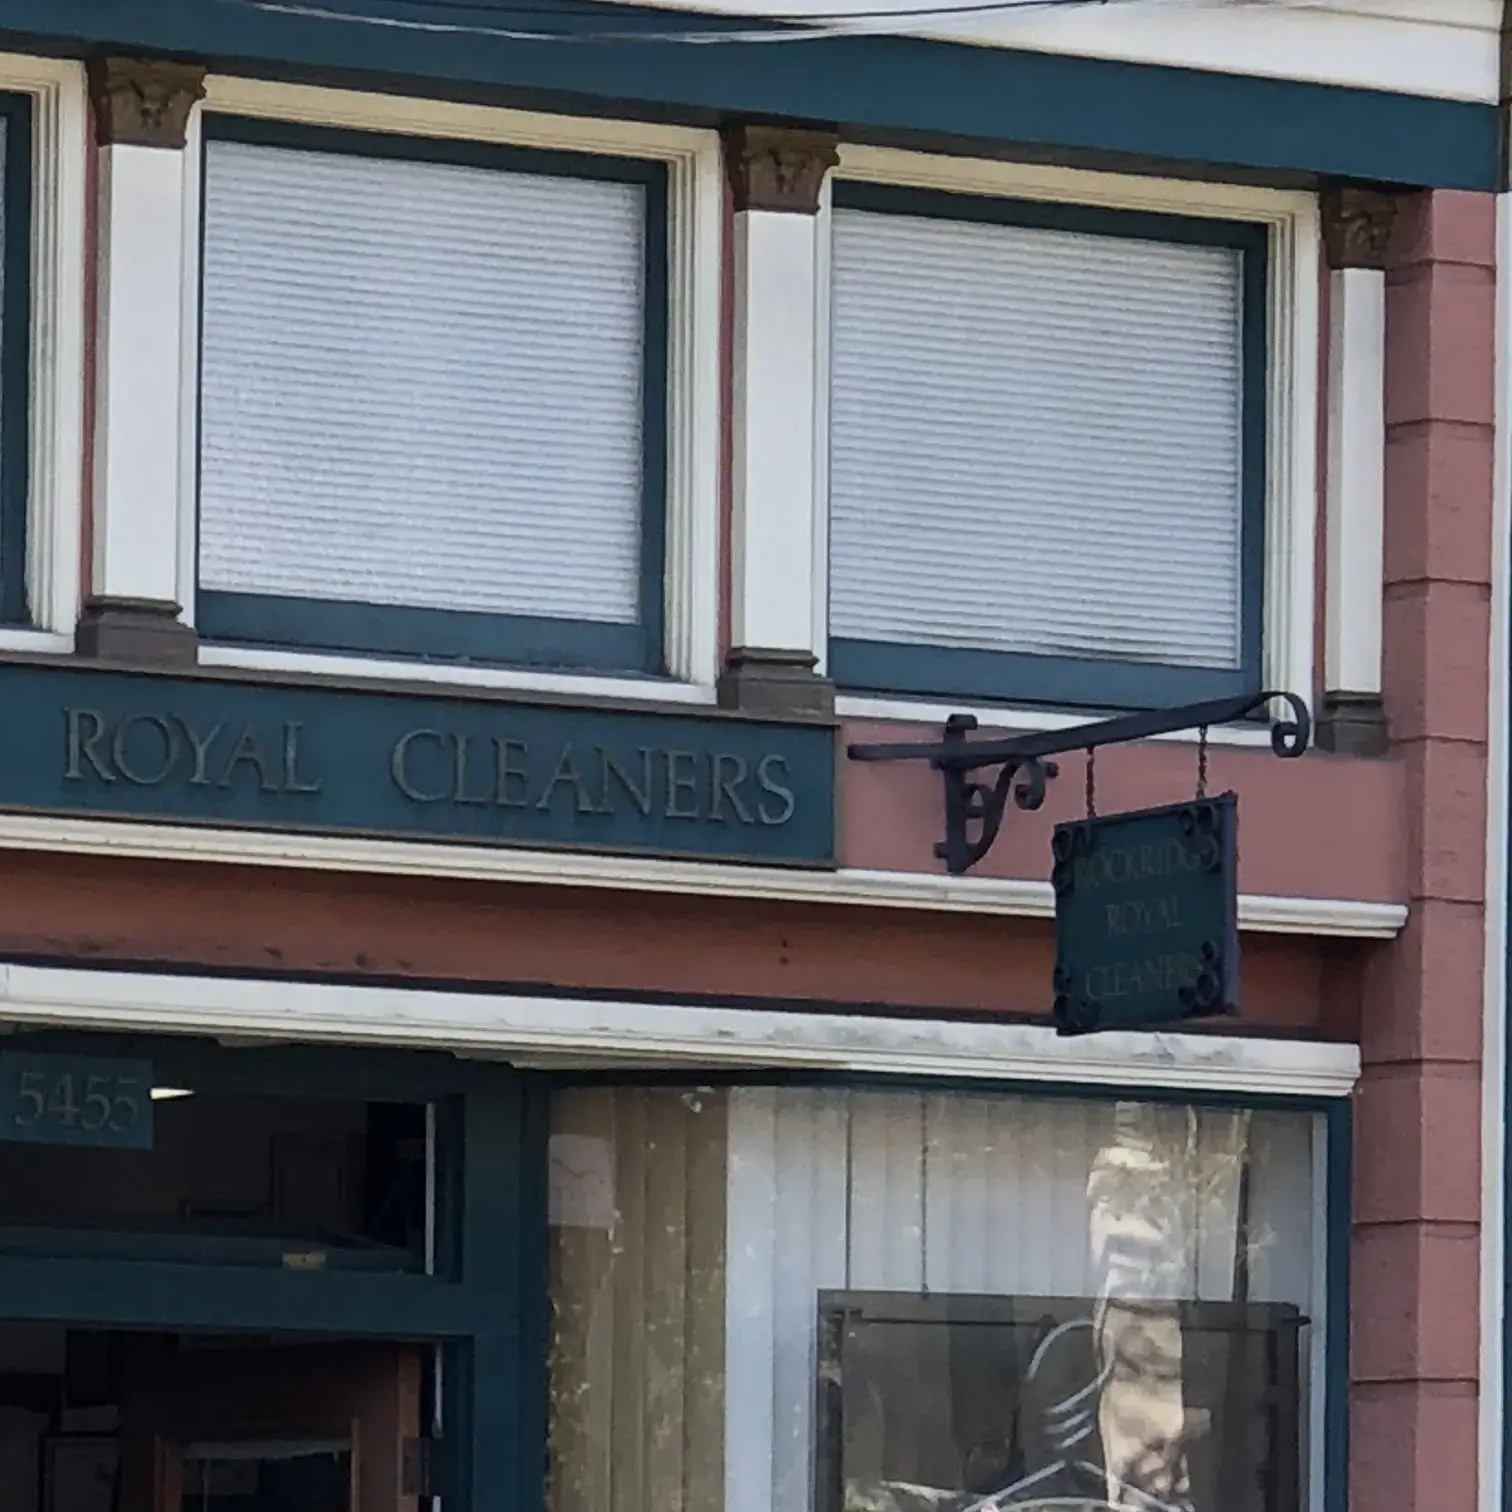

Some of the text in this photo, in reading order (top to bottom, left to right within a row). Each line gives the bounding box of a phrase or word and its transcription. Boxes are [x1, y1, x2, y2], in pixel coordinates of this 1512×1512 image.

[61, 706, 322, 793] ROYAL
[391, 727, 796, 826] CLEANERS
[14, 1071, 139, 1131] 5455
